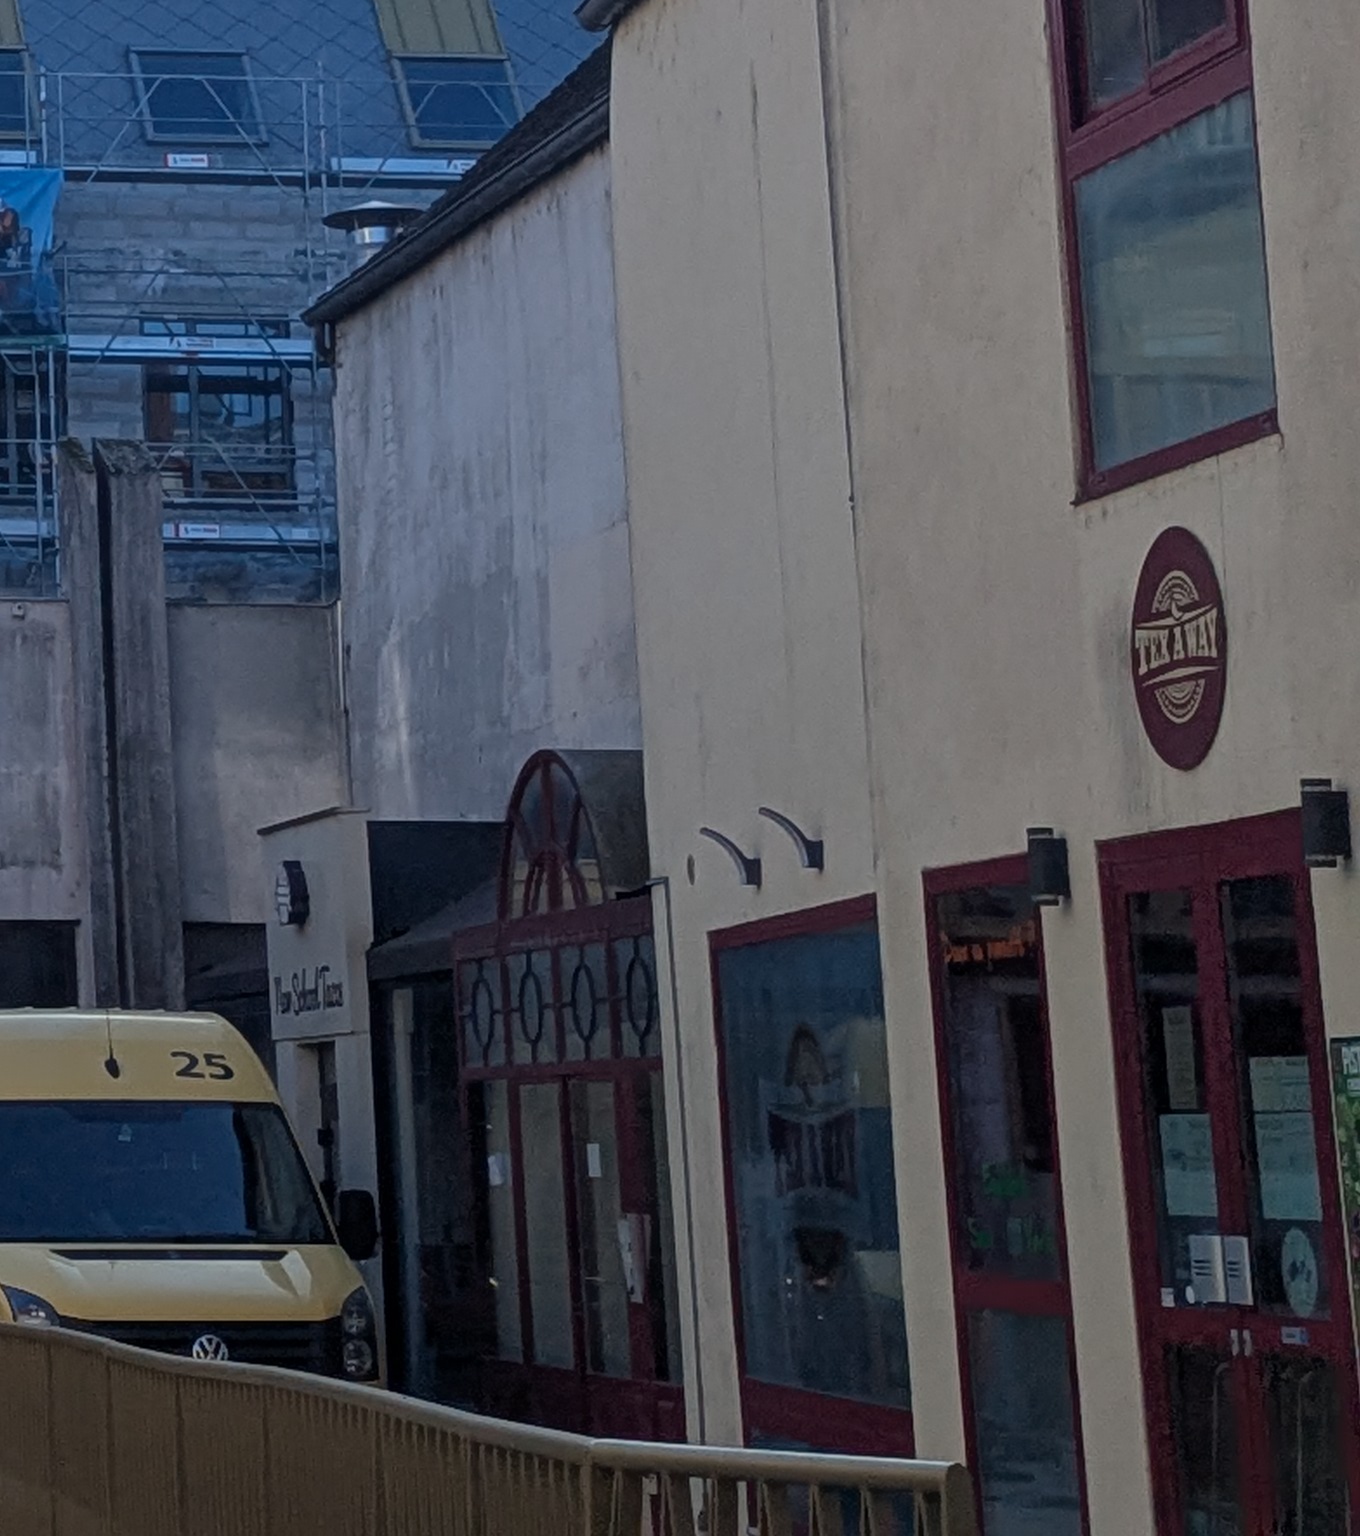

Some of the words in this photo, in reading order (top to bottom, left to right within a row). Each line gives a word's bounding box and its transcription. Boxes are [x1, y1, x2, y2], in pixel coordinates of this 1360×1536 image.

[1135, 629, 1171, 676] TEX
[1173, 625, 1185, 661] A
[1184, 607, 1218, 658] WAY
[170, 1050, 234, 1081] 25
